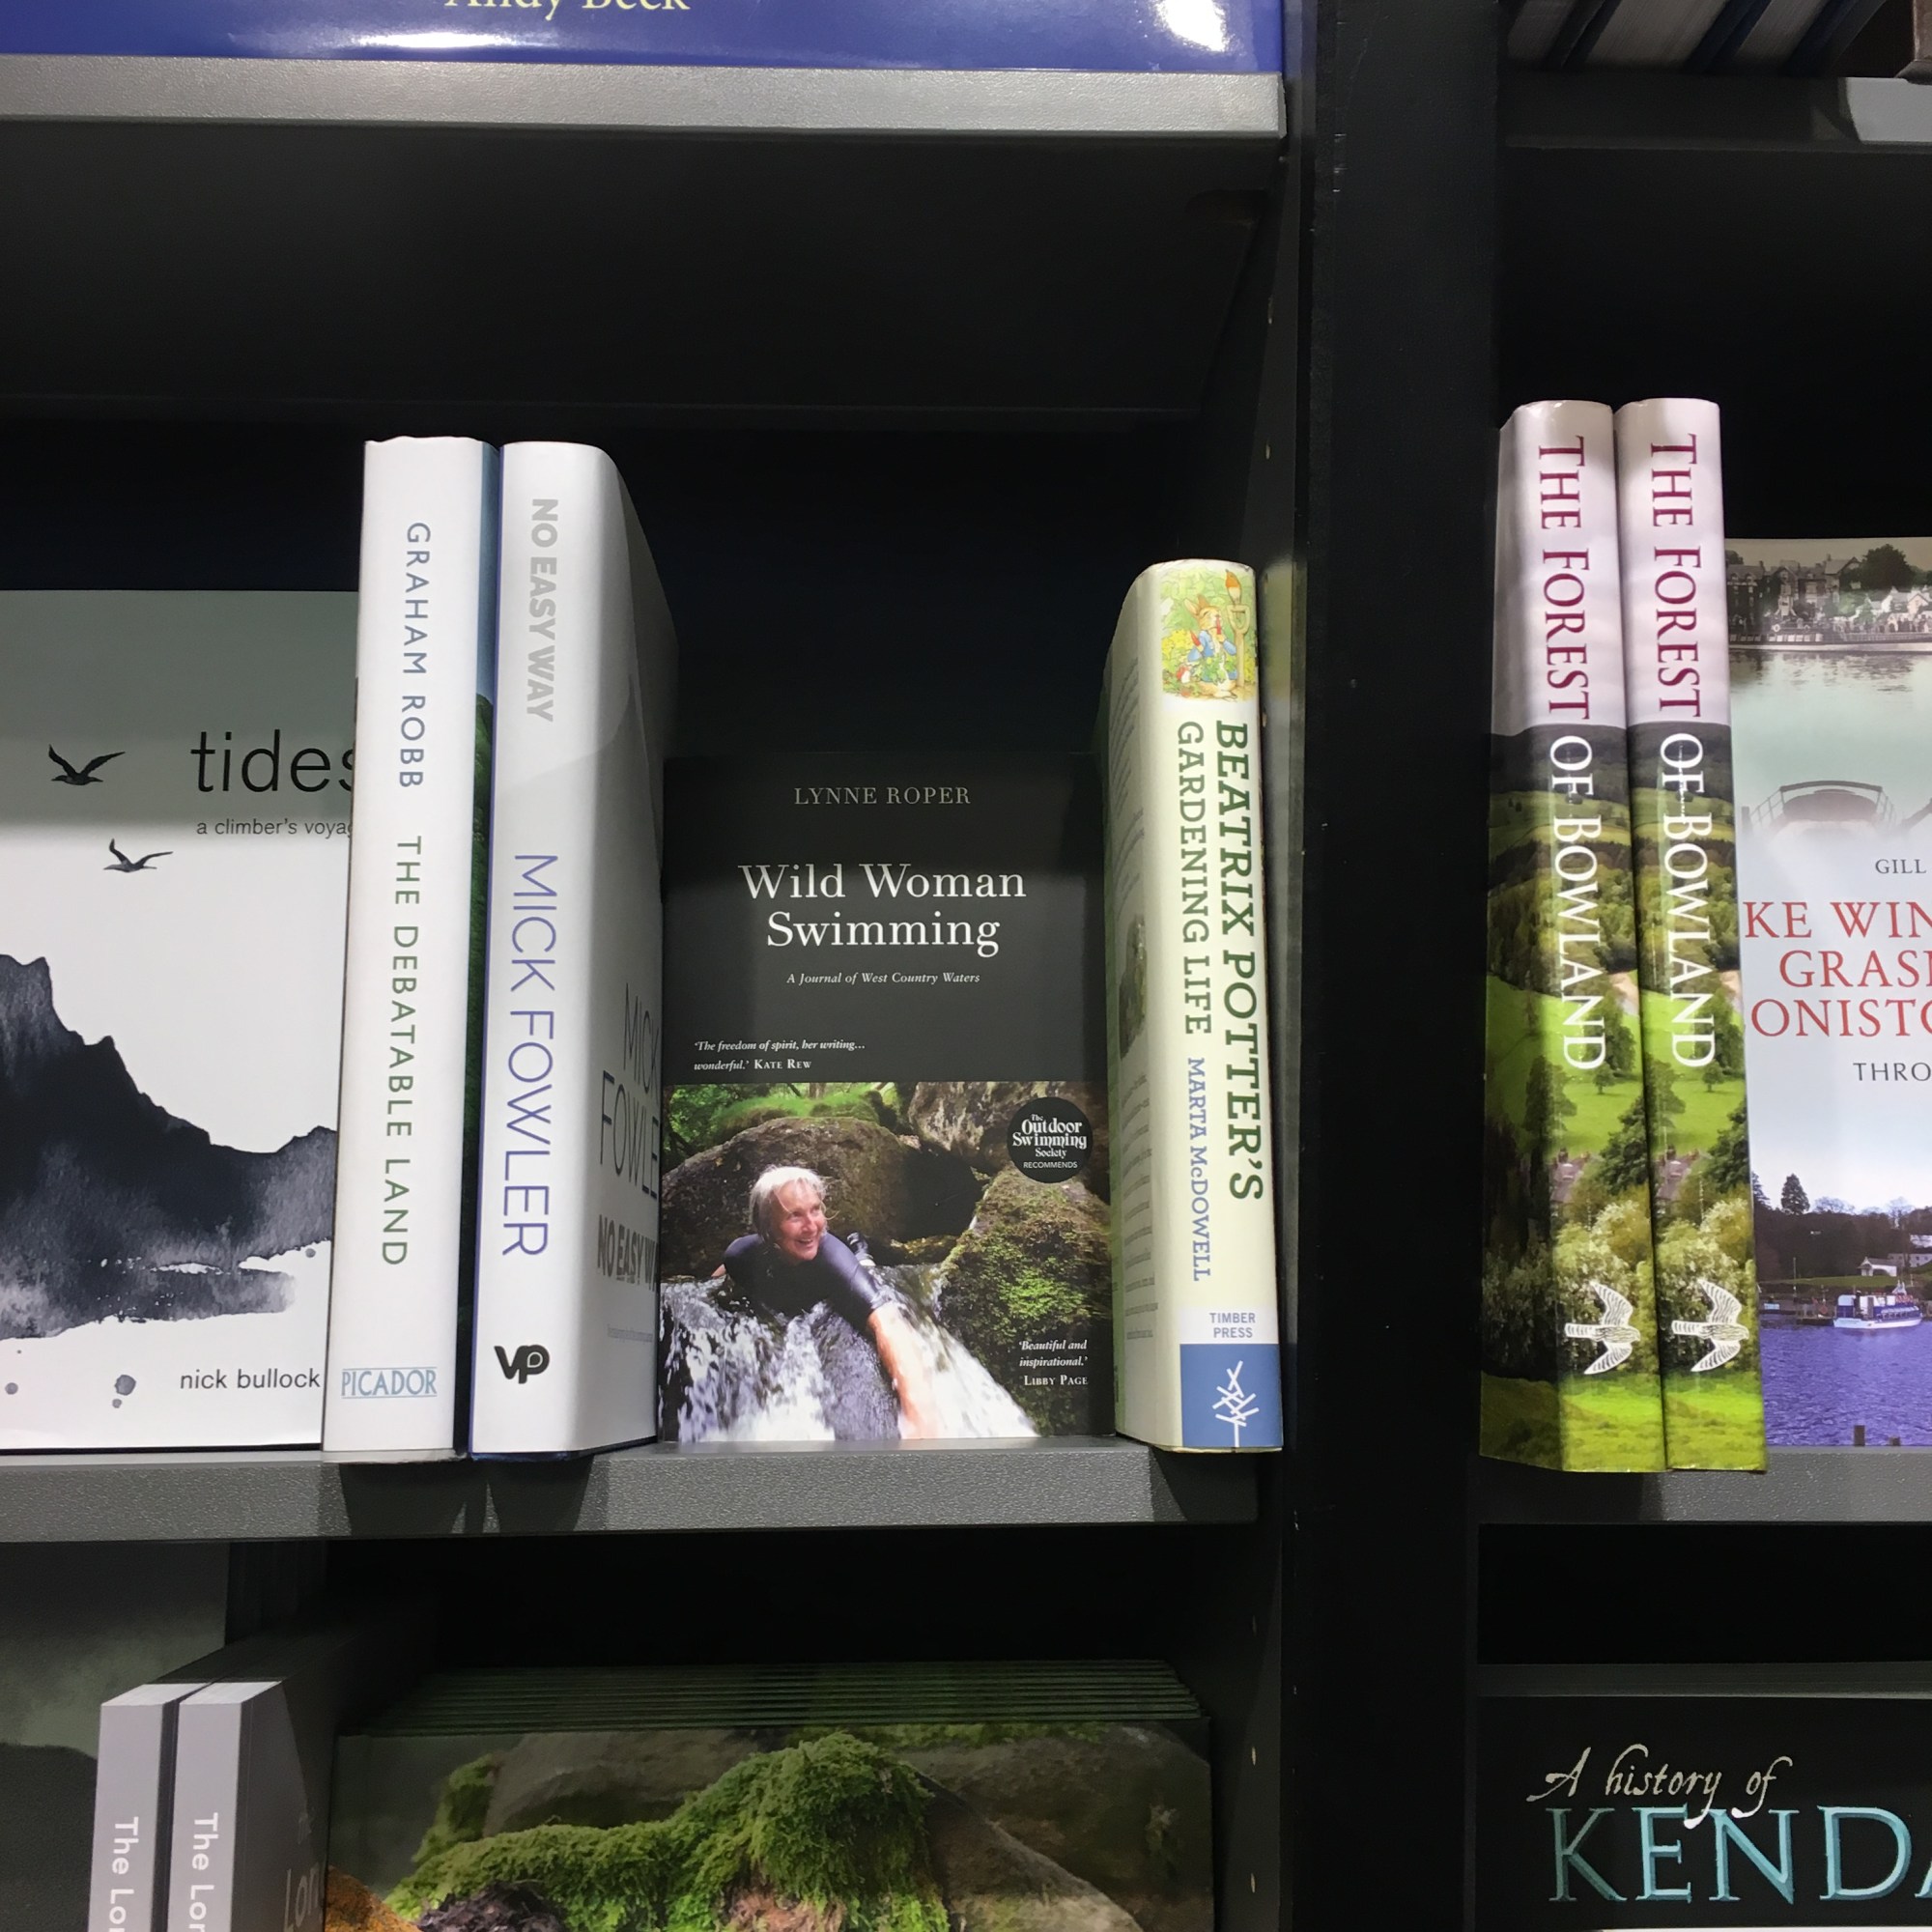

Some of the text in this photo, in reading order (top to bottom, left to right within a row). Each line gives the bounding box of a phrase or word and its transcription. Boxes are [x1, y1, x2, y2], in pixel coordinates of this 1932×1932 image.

[526, 498, 558, 723] NO EASY WAY
[399, 522, 431, 787] GRAHAM ROBB
[1538, 435, 1607, 1069] THE FOREST OF BOWLAND
[1650, 432, 1716, 1067] THE FOREST OF BOWLAND
[794, 786, 971, 805] LYNNE ROPER
[196, 822, 207, 835] a
[214, 818, 298, 835] climber’s
[738, 863, 1026, 899] Wild Woman
[1178, 721, 1212, 1035] GARDENING LIFE
[1875, 859, 1927, 874] GILL
[767, 911, 1001, 957] Swimming
[1743, 901, 1812, 938] KE
[786, 972, 980, 986] A Journal of West Country Waters
[1216, 720, 1264, 1201] BEATRIX POTTER’S
[1779, 950, 1932, 988] GRAS
[382, 836, 422, 1265] THE DEBATABLE LAND
[501, 854, 558, 1256] MICK FOWLER
[623, 982, 659, 1107] MICK
[717, 1040, 756, 1053] freedom
[758, 1039, 772, 1052] of
[771, 1039, 800, 1051] spirit,
[802, 1039, 818, 1050] her
[1012, 1131, 1088, 1150] Swimming
[1021, 1118, 1082, 1135] Outdoor
[1035, 1147, 1067, 1159] Society
[1187, 1057, 1211, 1282] MARTA McDOWELL
[597, 1214, 616, 1277] NO
[616, 1223, 643, 1286] EASY
[1067, 1339, 1088, 1350] and
[1209, 1312, 1256, 1339] TIMBER PRESS
[180, 1368, 321, 1389] nick bullock
[341, 1369, 438, 1397] PICADOR
[1526, 1744, 1794, 1830] A history of
[192, 1812, 219, 1871] The
[1545, 1804, 1932, 1905] KEND
[108, 1816, 139, 1932] The Lo
